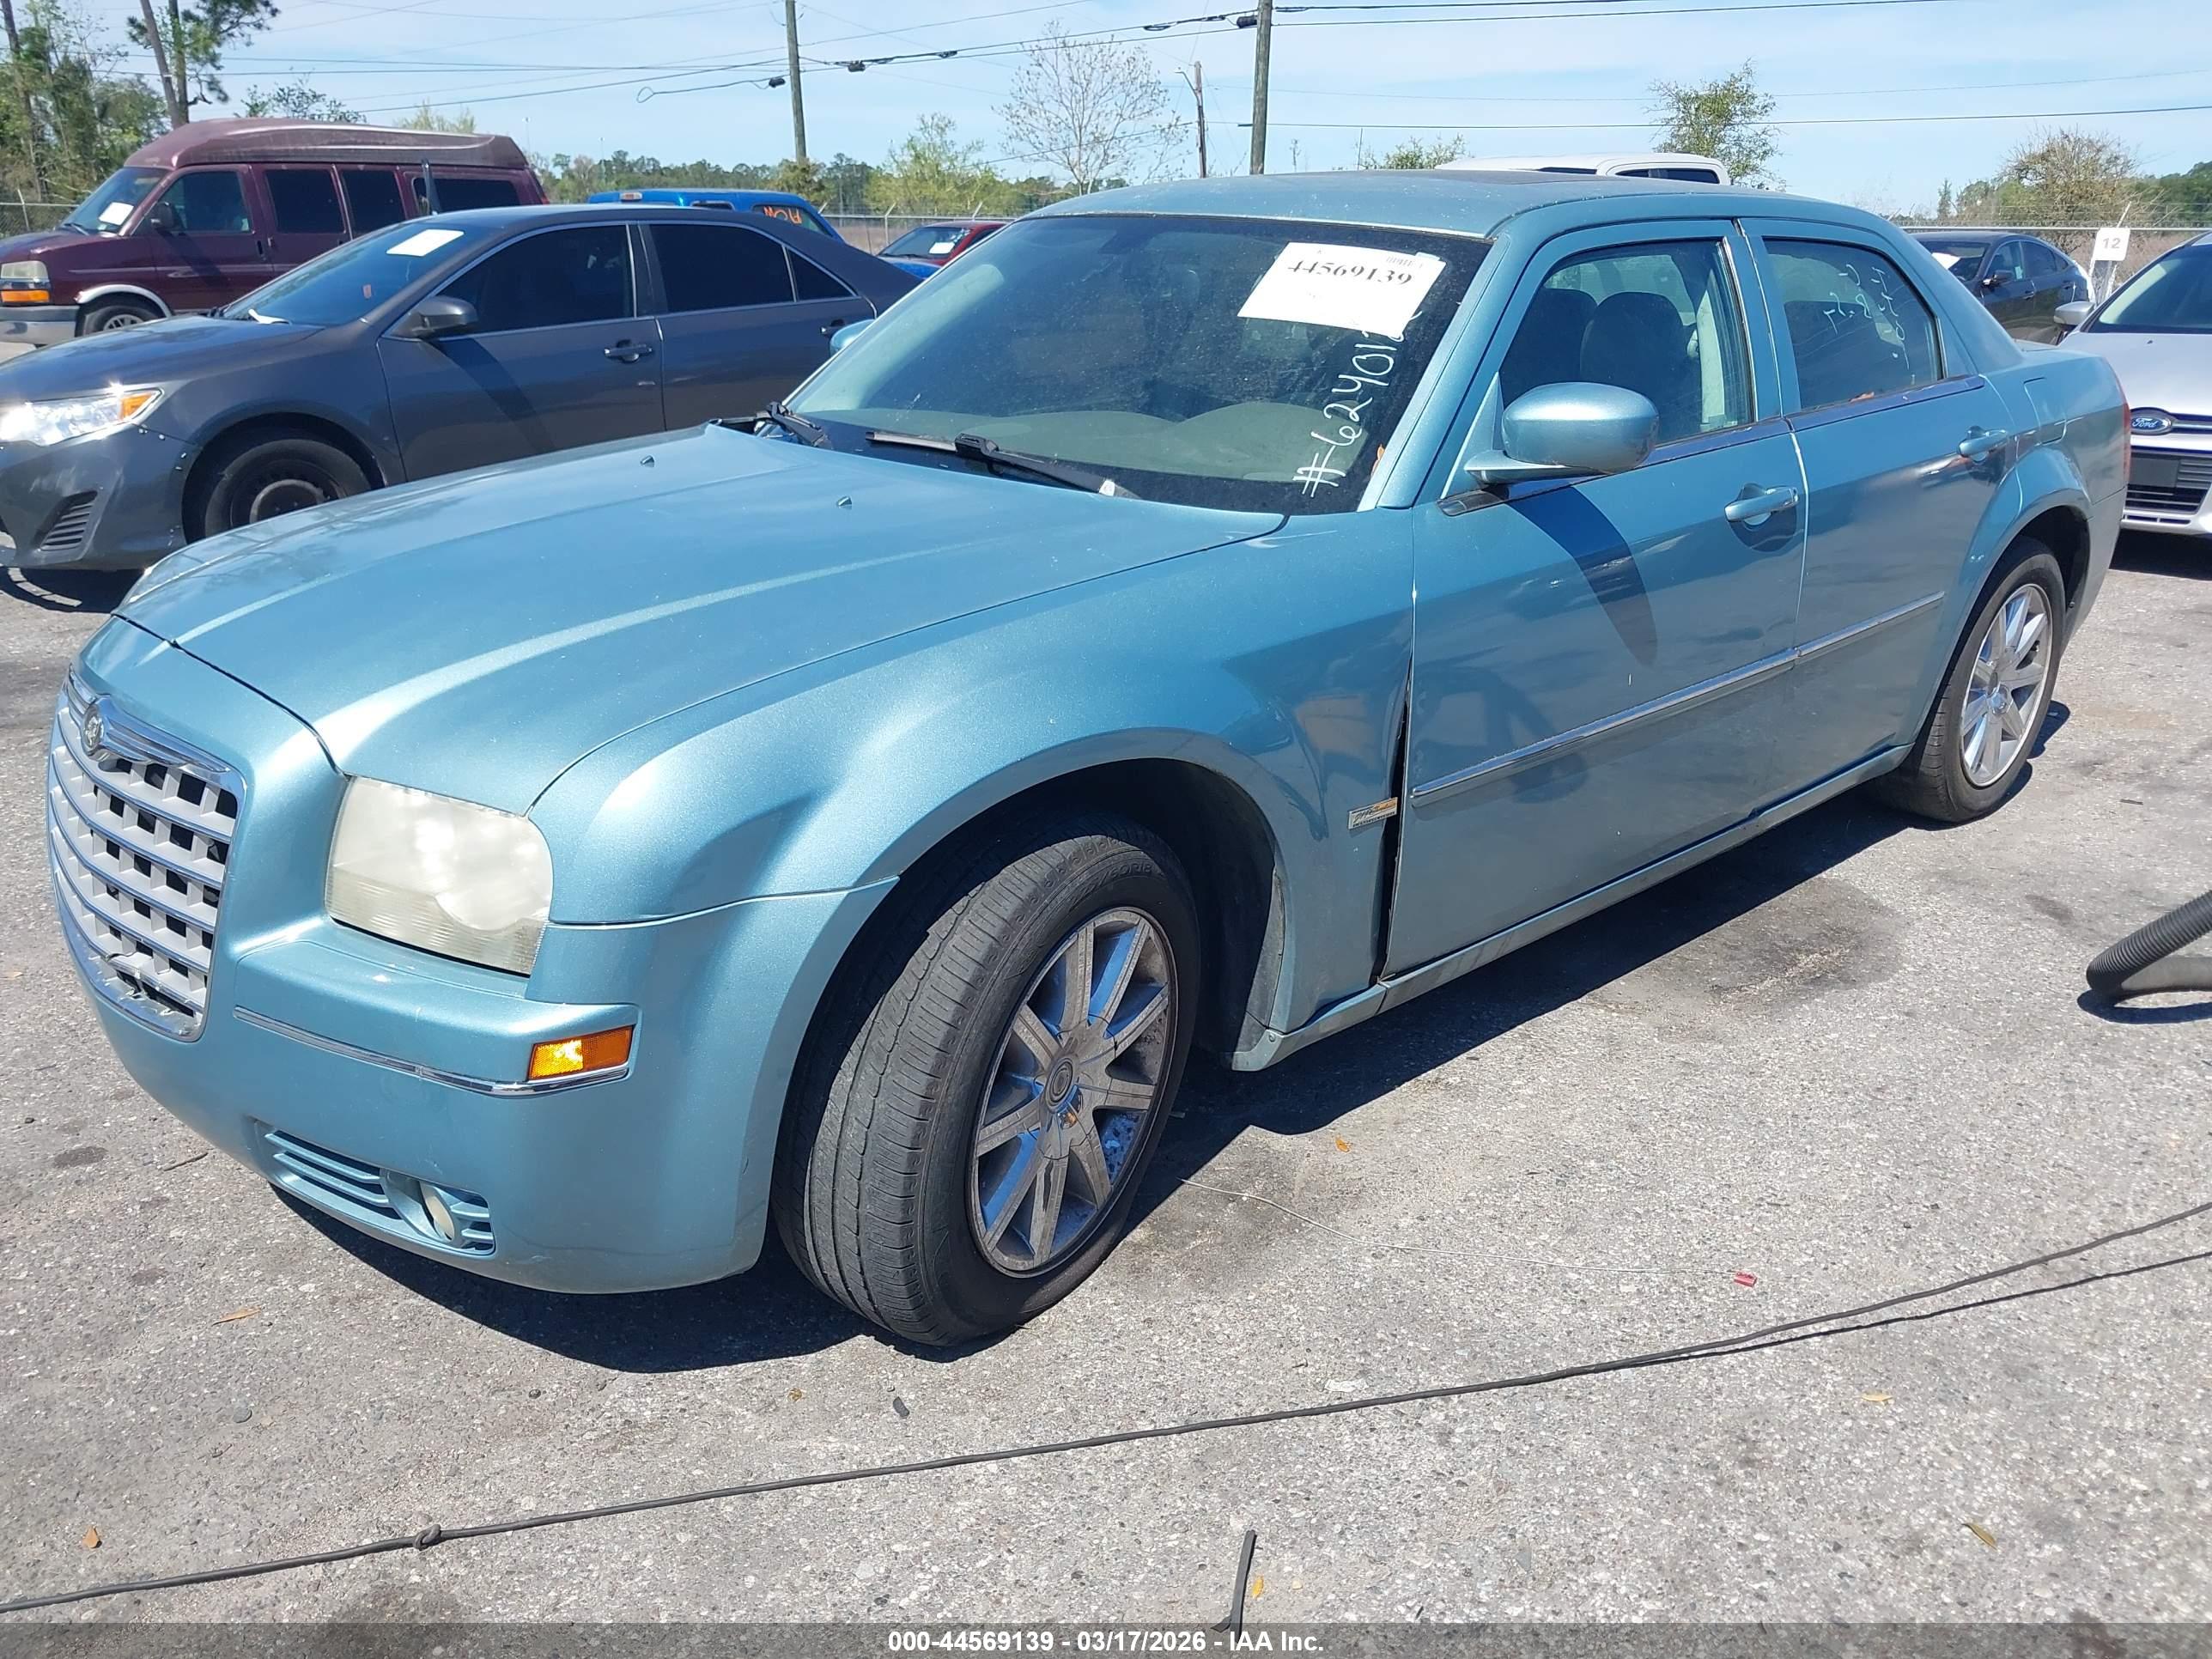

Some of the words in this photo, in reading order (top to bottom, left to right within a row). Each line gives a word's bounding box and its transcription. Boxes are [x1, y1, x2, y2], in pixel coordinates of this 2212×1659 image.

[2103, 237, 2121, 249] 12
[1287, 259, 1413, 284] 44569139
[2132, 417, 2159, 428] Ford
